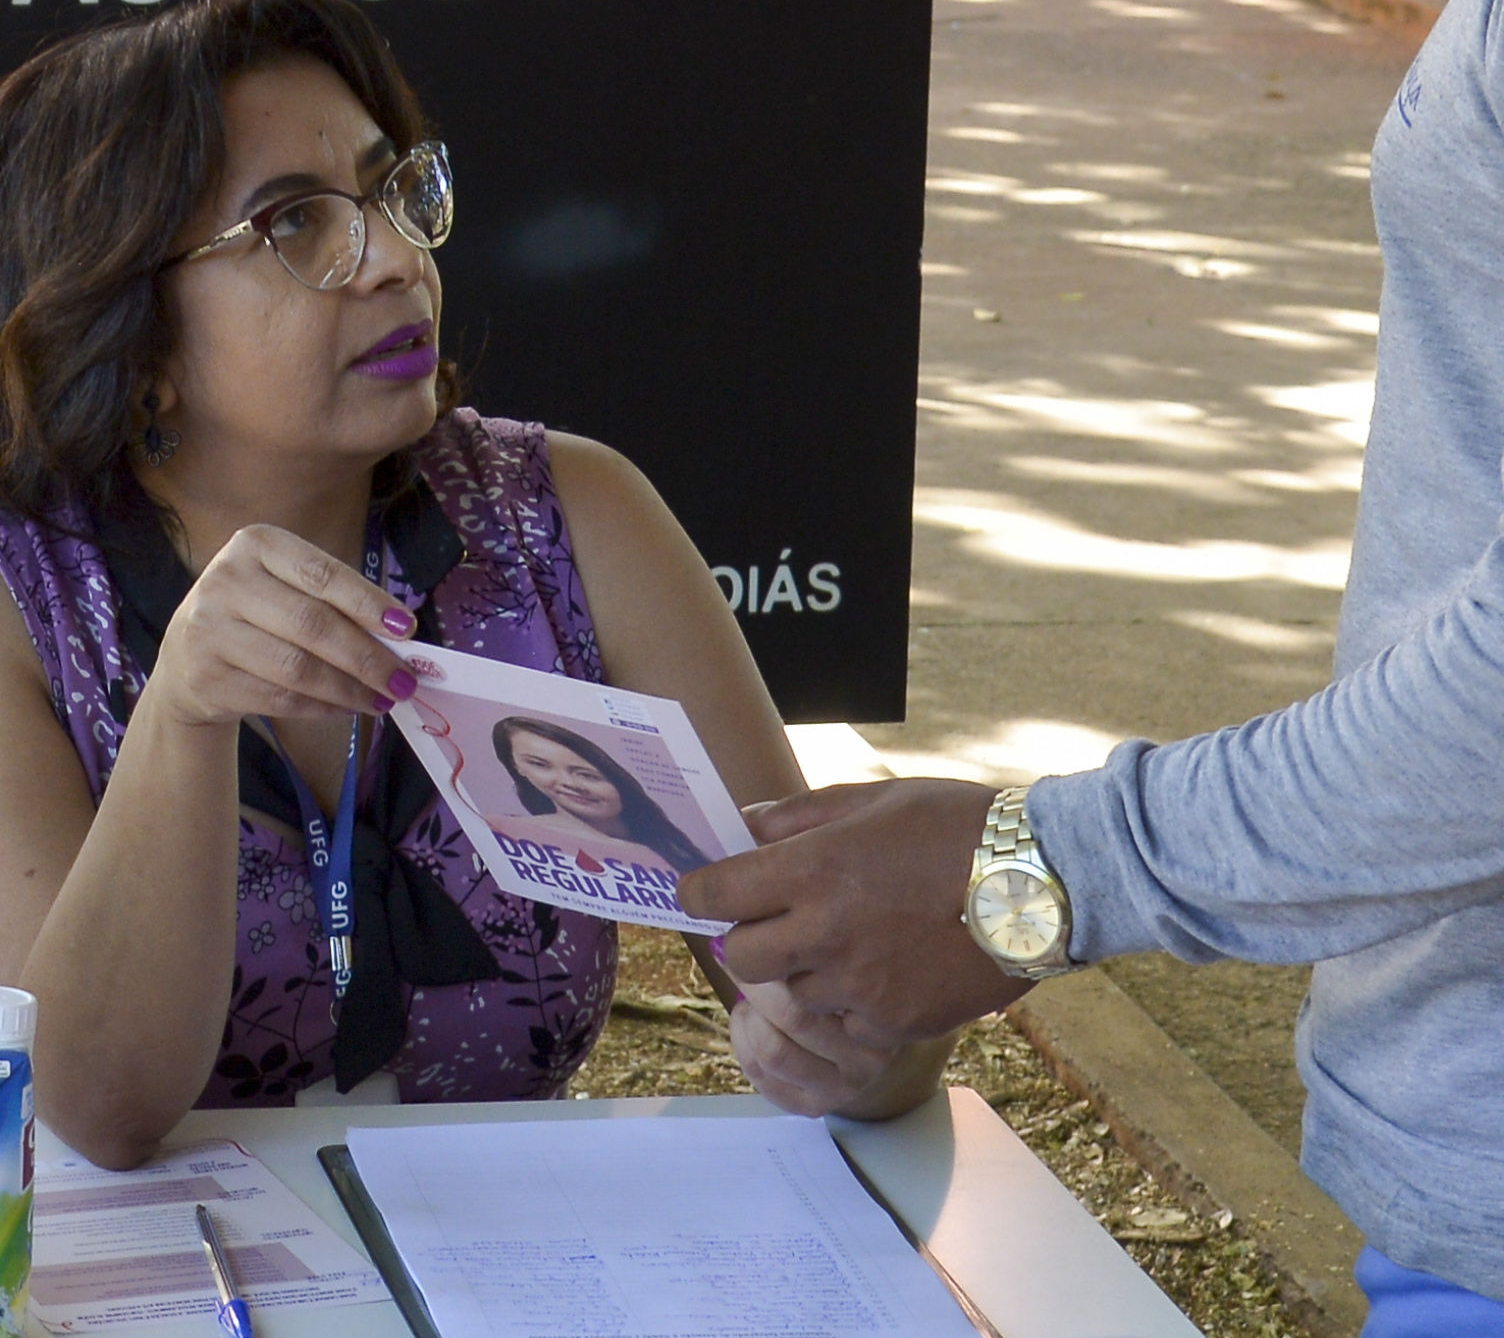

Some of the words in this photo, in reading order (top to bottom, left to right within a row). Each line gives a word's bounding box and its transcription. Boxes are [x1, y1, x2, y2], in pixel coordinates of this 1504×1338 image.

[710, 547, 841, 614] OIÁS
[308, 818, 329, 868] UFG
[491, 830, 574, 871] DOE
[603, 857, 679, 890] SAN
[331, 880, 349, 930] UFG
[509, 858, 684, 913] REGULAR
